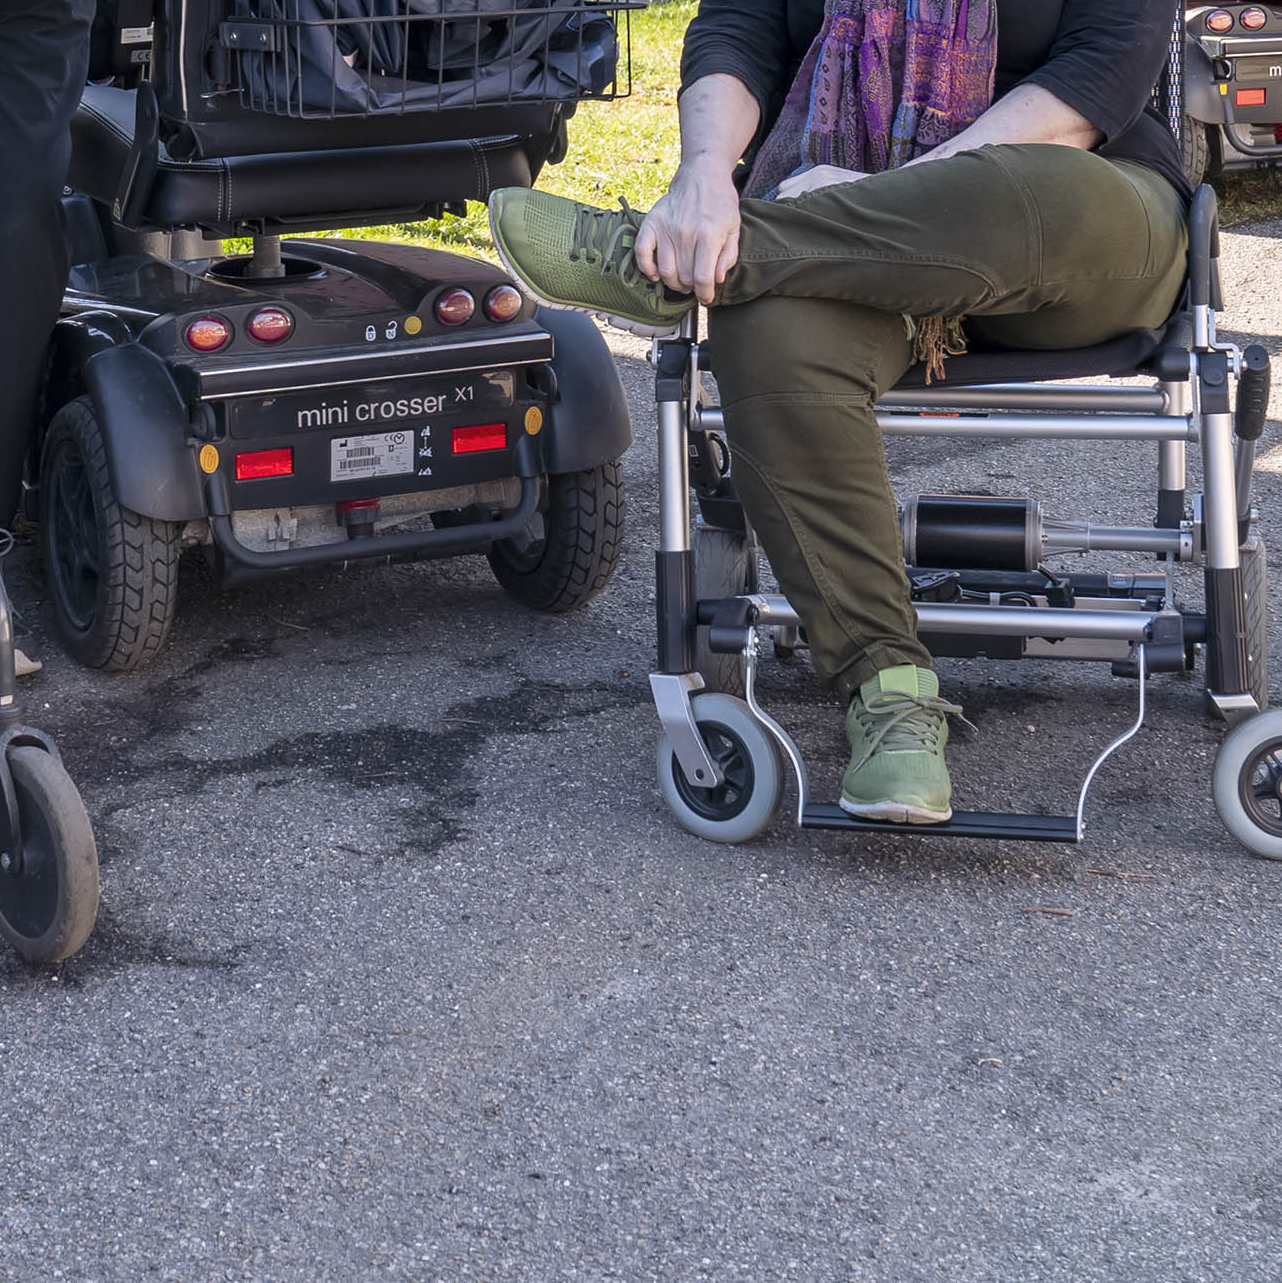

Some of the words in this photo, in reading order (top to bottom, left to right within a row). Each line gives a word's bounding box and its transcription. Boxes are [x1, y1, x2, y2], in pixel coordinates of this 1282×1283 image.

[297, 399, 349, 428] mini
[355, 394, 447, 421] crosser
[454, 386, 474, 402] X1
